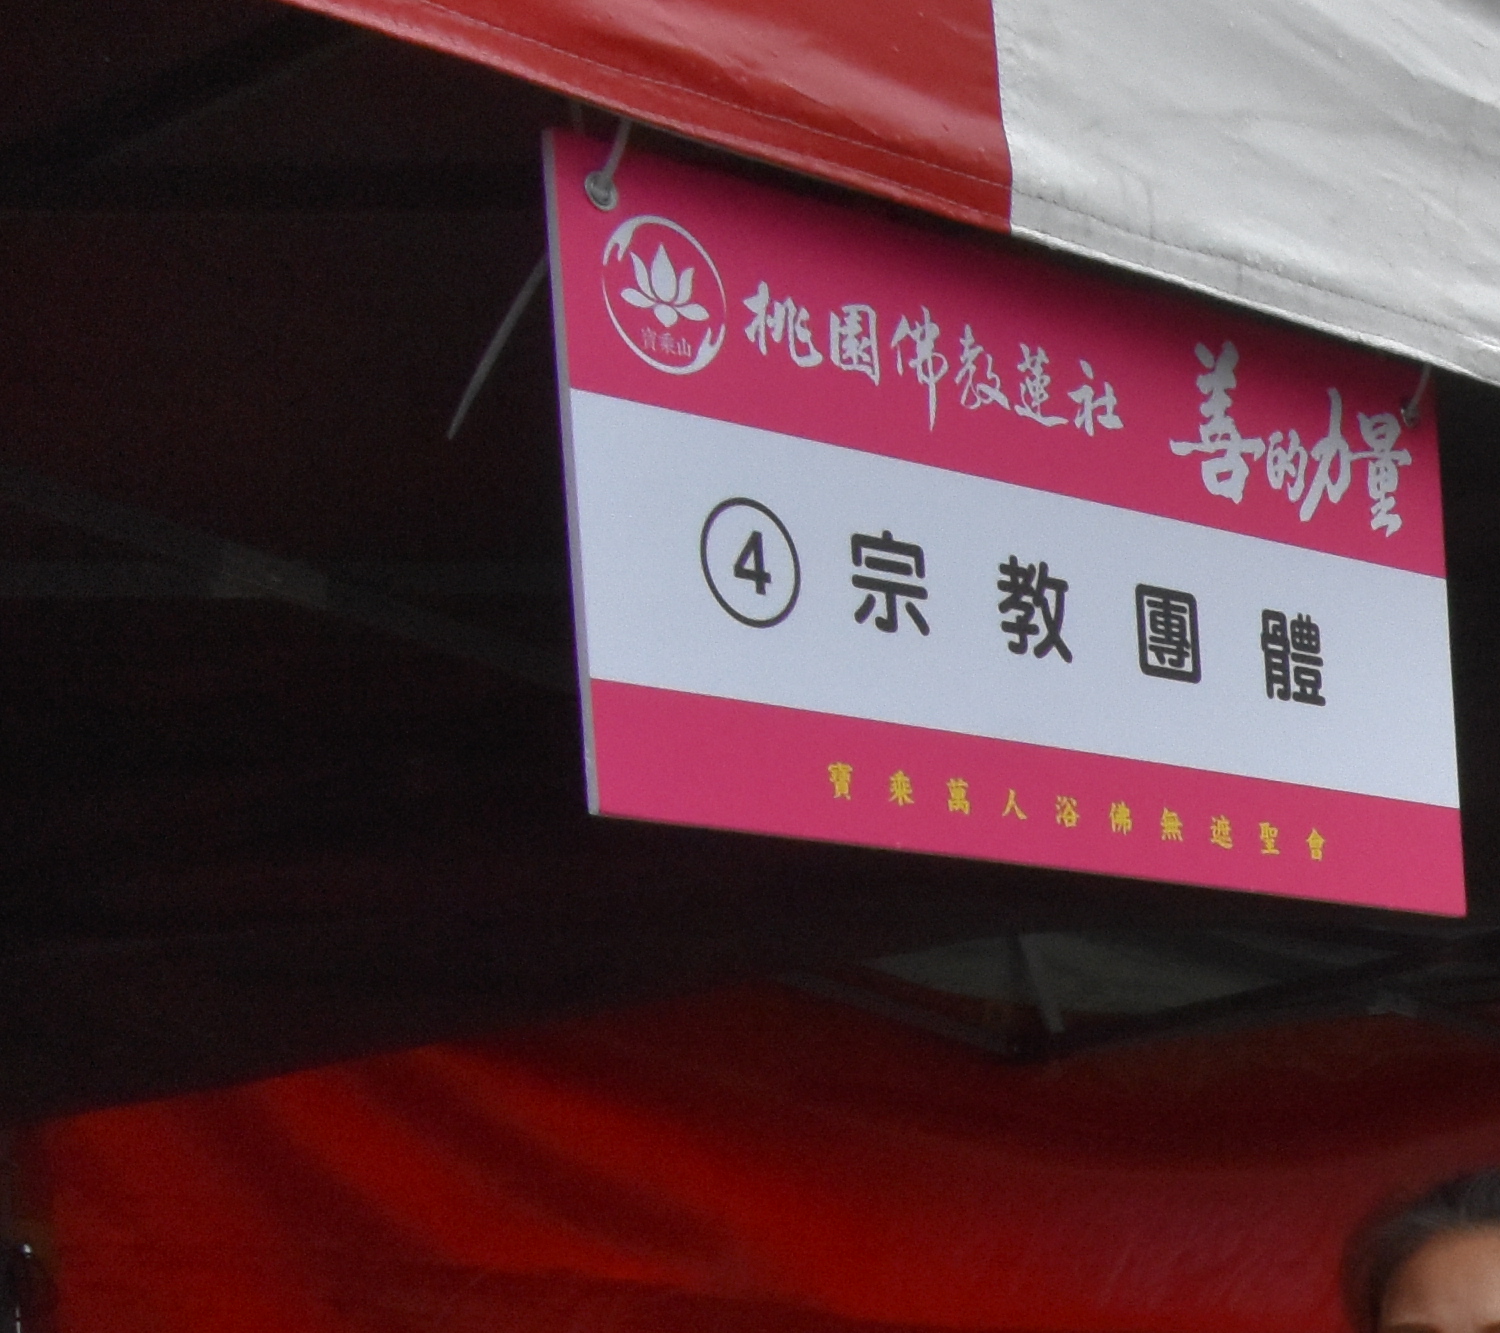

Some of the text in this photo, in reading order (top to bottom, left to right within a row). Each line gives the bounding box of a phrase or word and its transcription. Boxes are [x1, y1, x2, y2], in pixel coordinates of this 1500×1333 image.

[743, 280, 1413, 537] 桃園佛教蓮社 善的力量
[850, 530, 1327, 708] 宗教團體
[828, 761, 1327, 862] 寶乘萬人浴佛無遮聖會
